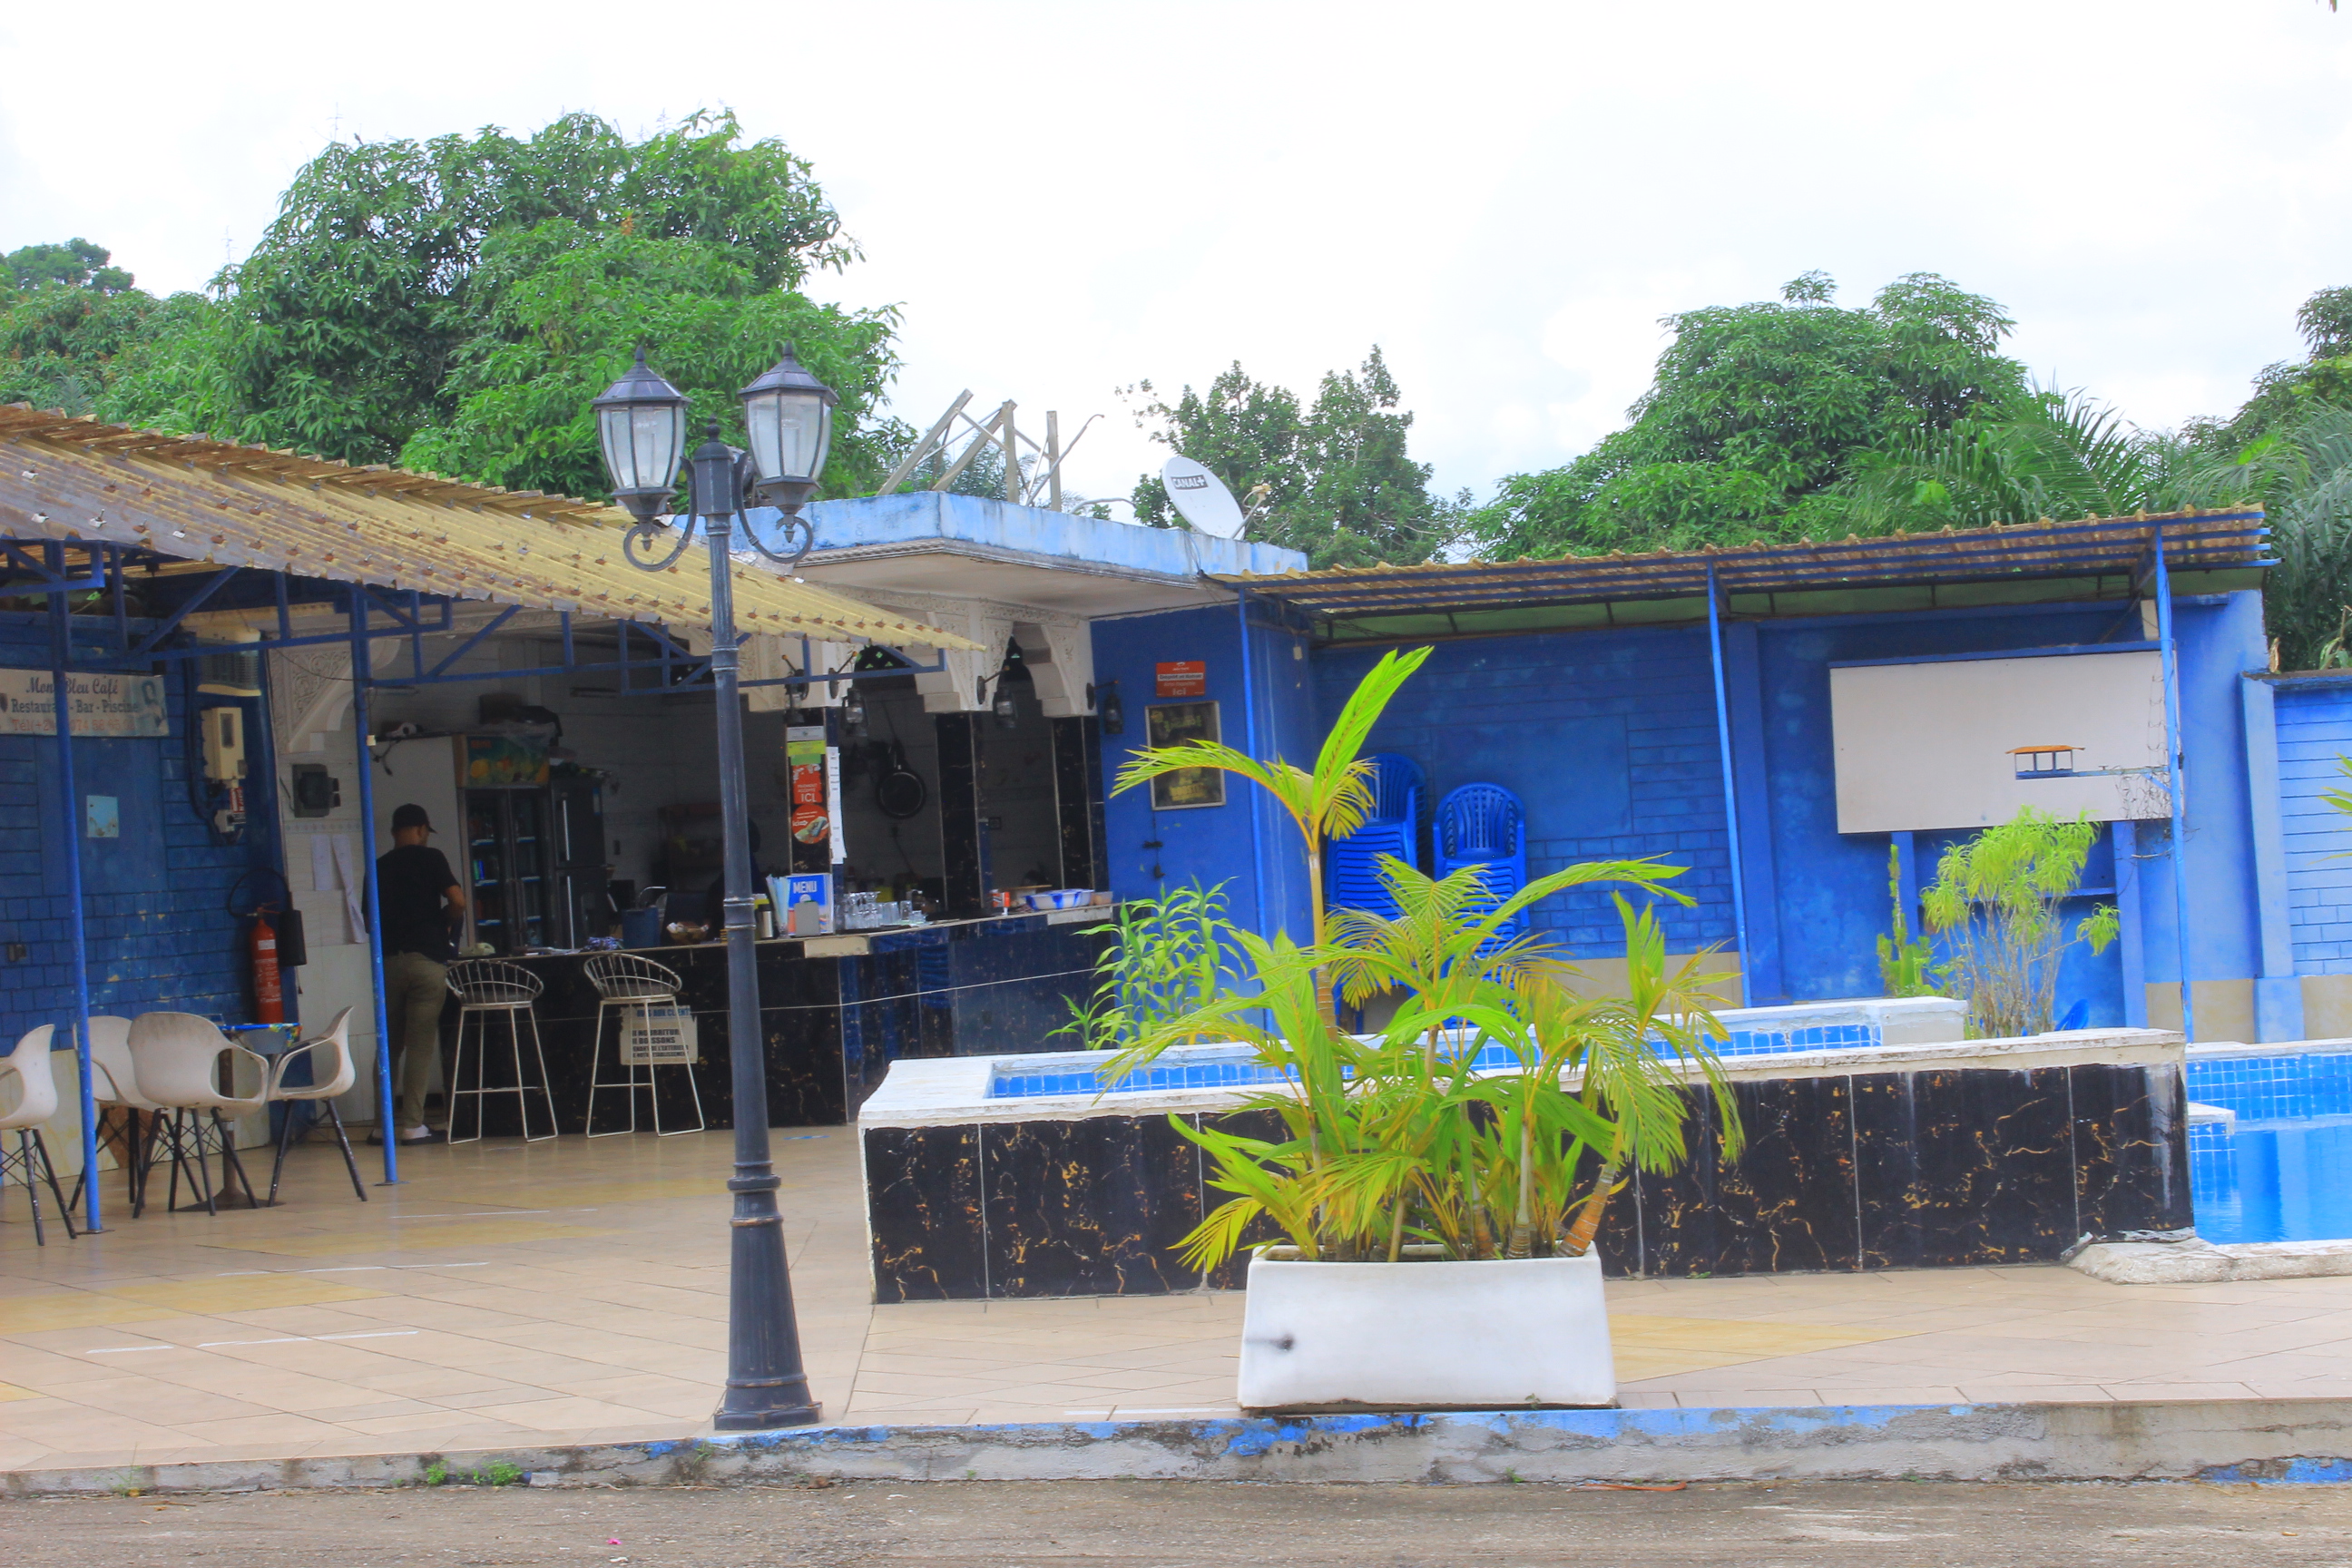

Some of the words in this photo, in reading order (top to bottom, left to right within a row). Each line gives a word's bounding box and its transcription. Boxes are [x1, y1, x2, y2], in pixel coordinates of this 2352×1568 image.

[1172, 476, 1205, 488] CANAL+
[25, 677, 55, 695] Mon
[65, 678, 89, 694] Bleu
[93, 679, 118, 700] Café
[11, 698, 56, 713] Restaura
[75, 699, 94, 714] Bar
[792, 880, 818, 895] MENU
[639, 1036, 676, 1044] BOSSONS
